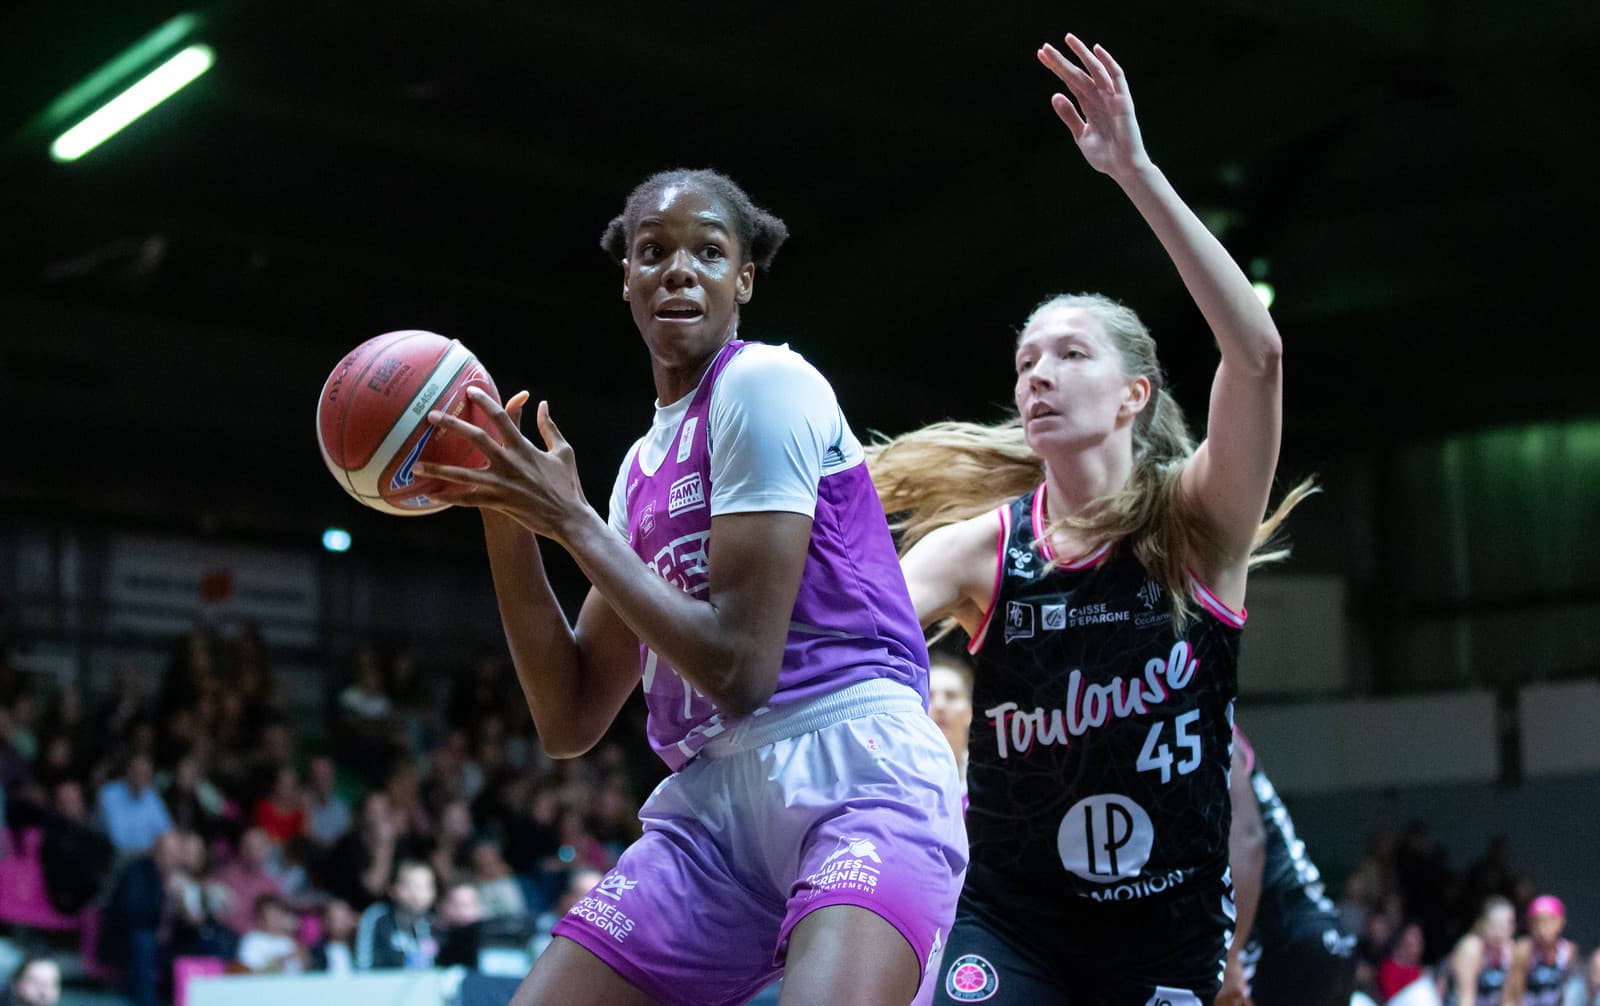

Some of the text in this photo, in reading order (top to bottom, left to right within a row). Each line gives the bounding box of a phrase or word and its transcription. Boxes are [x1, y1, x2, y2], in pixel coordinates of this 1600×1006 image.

[670, 481, 700, 504] FAMY
[985, 640, 1199, 763] Toulouse
[1136, 708, 1201, 784] 45
[1077, 869, 1185, 902] MOTION
[577, 896, 636, 932] RÉNÉES
